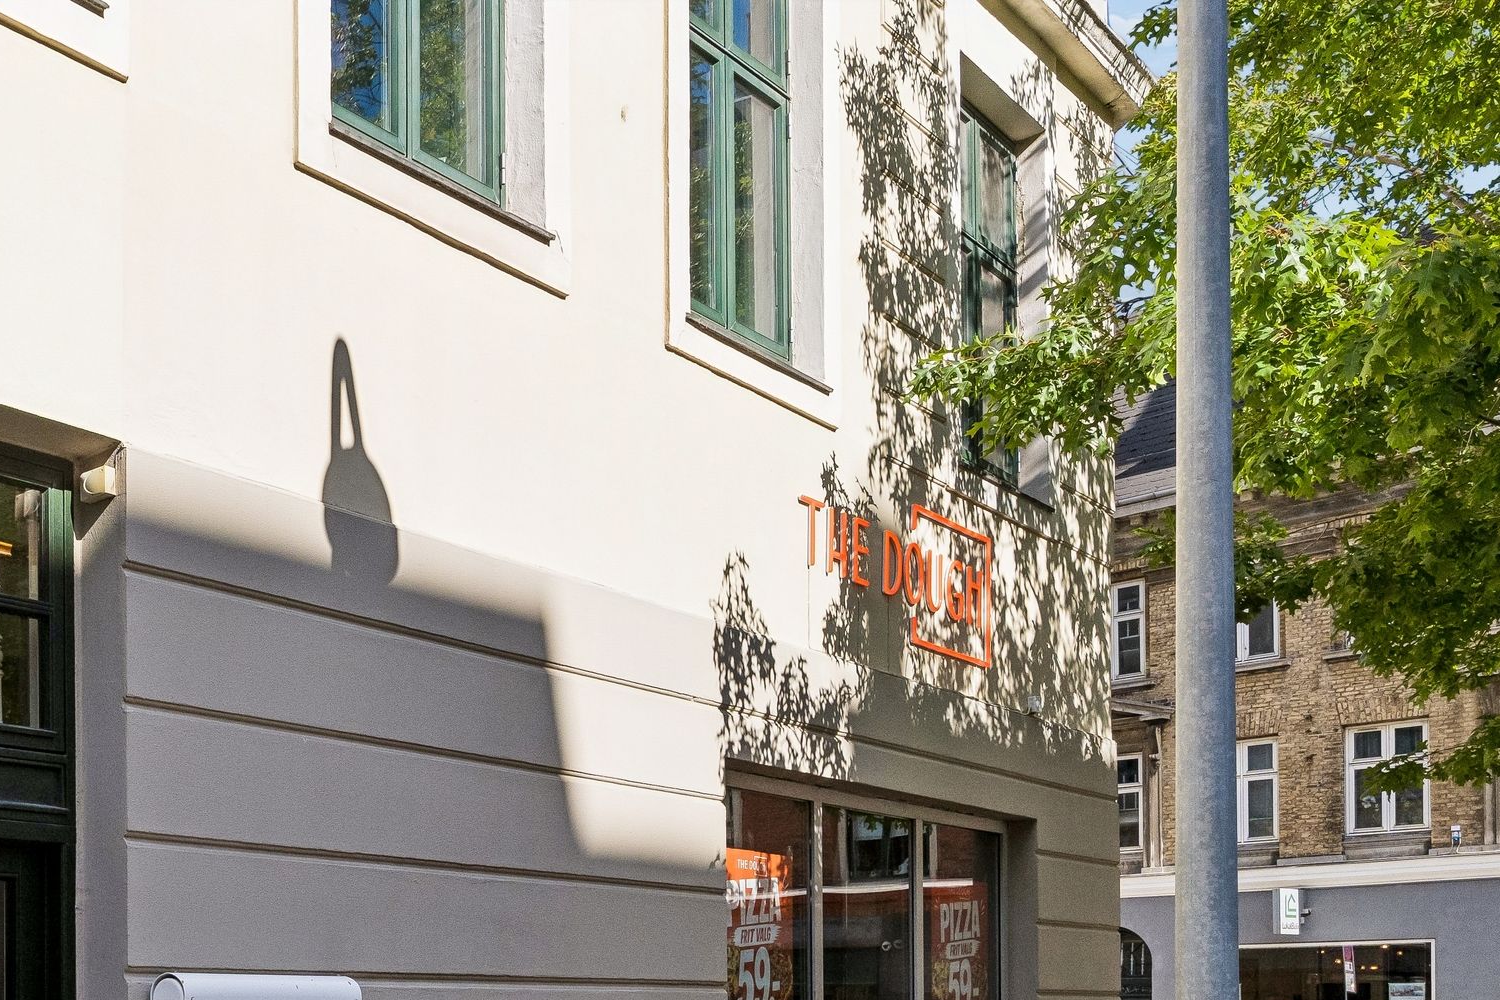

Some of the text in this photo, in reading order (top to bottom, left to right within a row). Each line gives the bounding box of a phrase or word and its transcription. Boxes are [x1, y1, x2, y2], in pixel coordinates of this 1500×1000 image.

[798, 494, 984, 629] THE DOUGH
[737, 859, 749, 870] THE
[726, 877, 782, 927] PIZZA
[939, 900, 981, 943] PIZZA
[740, 927, 772, 944] FRIT VALG
